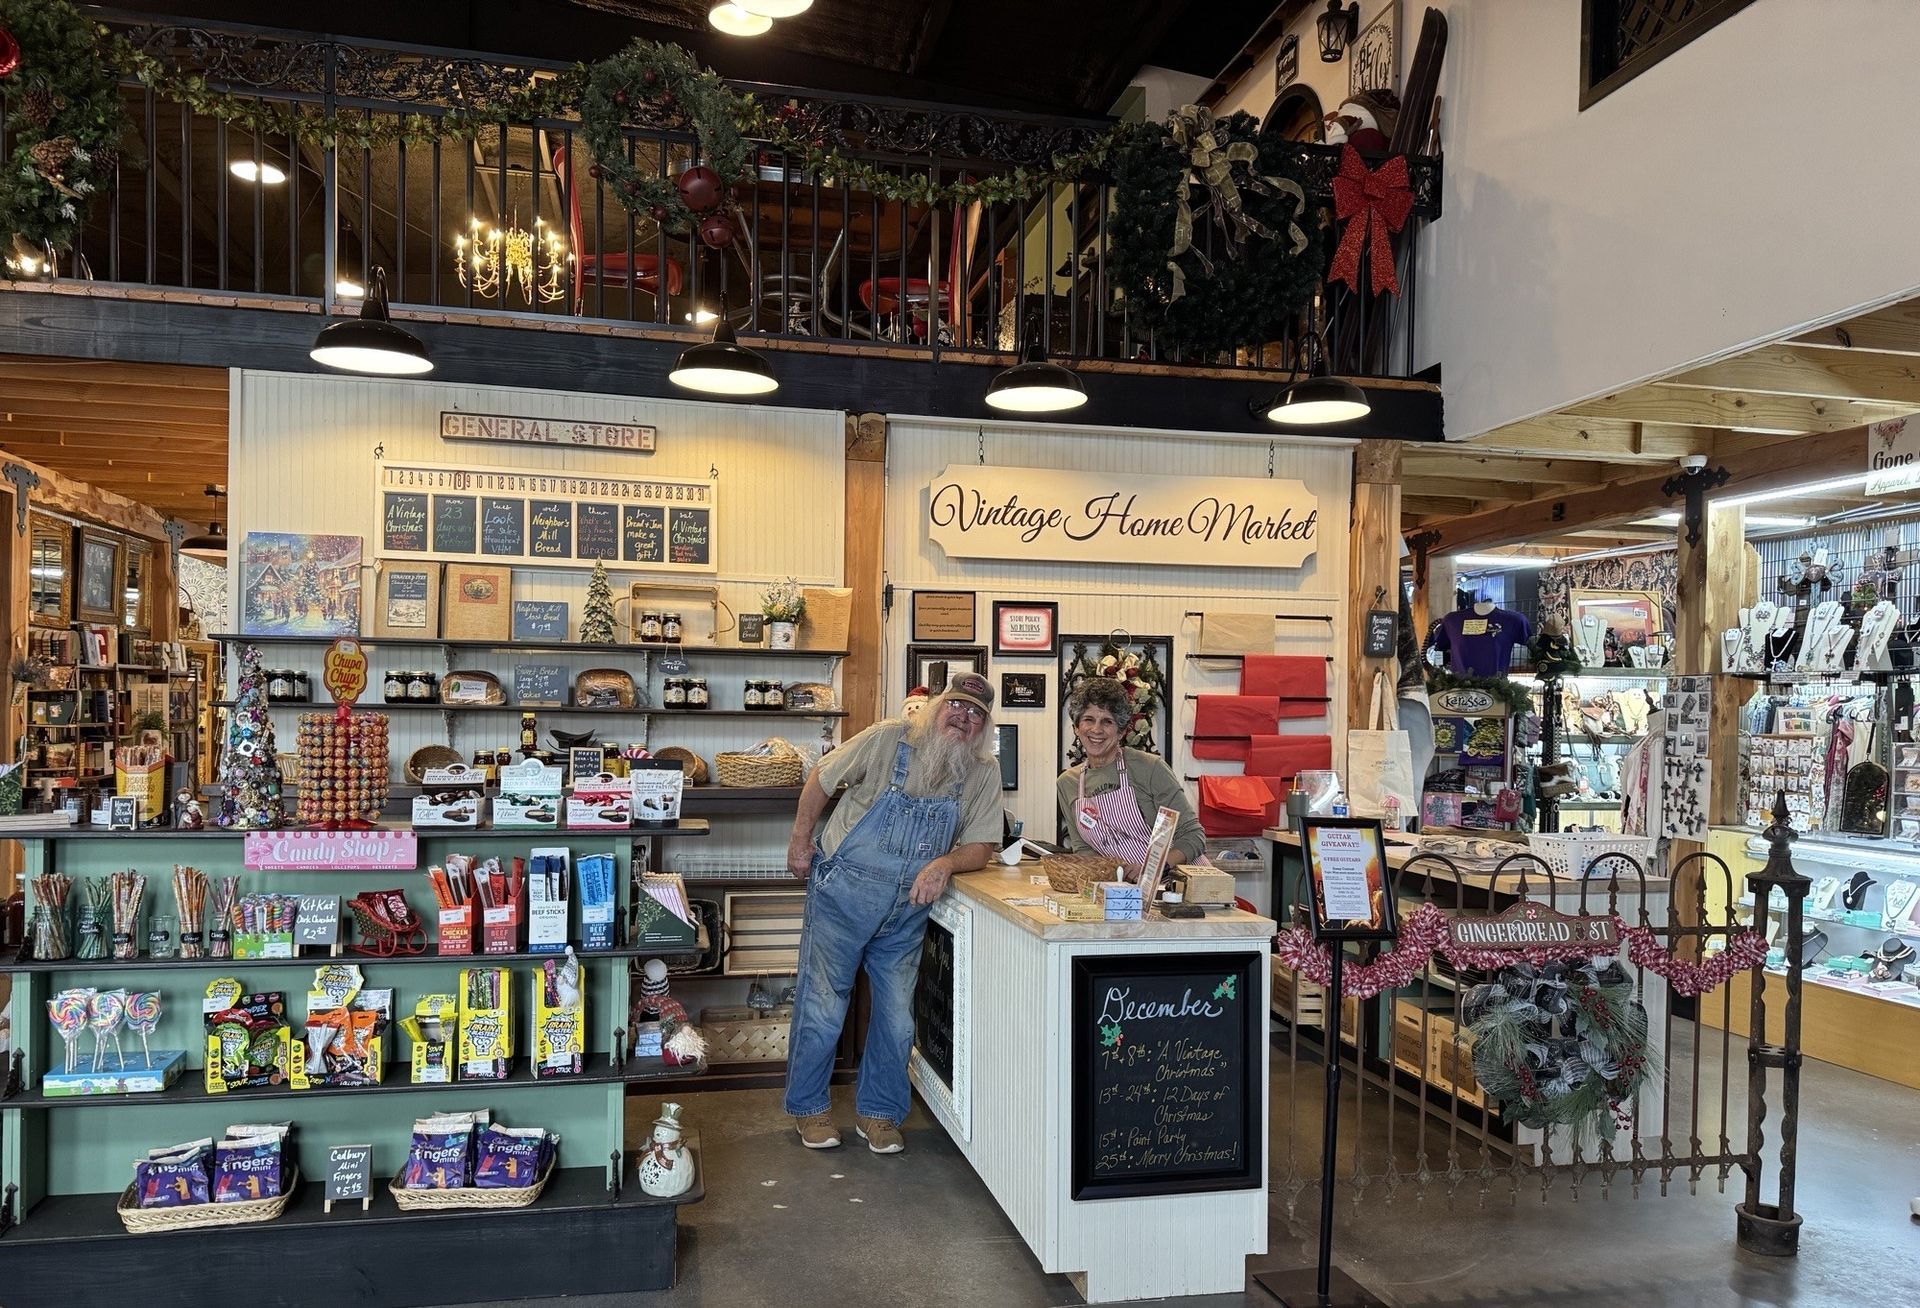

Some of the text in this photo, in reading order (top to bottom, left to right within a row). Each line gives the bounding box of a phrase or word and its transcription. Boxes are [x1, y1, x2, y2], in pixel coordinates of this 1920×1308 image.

[444, 415, 651, 449] GENERAL STORE
[1873, 451, 1913, 471] Gone
[390, 471, 394, 484] 1
[399, 471, 404, 484] 2
[409, 471, 414, 485] 3
[418, 472, 423, 486] 4
[428, 473, 433, 486] 5
[439, 473, 444, 486] 6
[457, 474, 462, 487] 8
[466, 474, 471, 488] 9
[476, 475, 483, 488] 10
[488, 475, 493, 489] 11
[497, 476, 504, 490] 12
[508, 477, 515, 490] 13
[519, 478, 526, 491] 14
[530, 479, 537, 492] 15
[540, 479, 547, 492] 16
[550, 480, 557, 493] 17
[560, 480, 567, 494] 18
[570, 480, 577, 494] 19
[579, 481, 587, 495] 20
[591, 482, 598, 495] 21
[601, 482, 608, 496] 22
[611, 483, 619, 497] 23
[622, 484, 630, 497] 24
[633, 484, 641, 498] 25
[644, 485, 652, 498] 26
[655, 486, 663, 499] 27
[666, 486, 673, 500] 28
[676, 487, 683, 500] 29
[686, 487, 694, 501] 30
[698, 488, 705, 501] 31
[388, 504, 425, 524] A Vintage
[440, 506, 463, 519] 23
[485, 509, 515, 524] Look
[930, 483, 1318, 546] Vintage Home Market
[386, 520, 424, 533] Christmas
[532, 512, 570, 530] Neighbor's
[626, 516, 663, 530] Bread Jam
[484, 524, 495, 535] for
[538, 529, 558, 541] Mill
[627, 529, 648, 539] make
[671, 519, 708, 538] A Vintage
[672, 532, 706, 545] Christmas
[491, 544, 512, 553] VHM
[535, 541, 562, 554] Bread
[580, 544, 607, 557] Wrap
[634, 541, 656, 551] great
[636, 549, 659, 561] gift!
[516, 603, 545, 617] Neighbor's
[1010, 615, 1041, 623] STORE POLICY
[1010, 624, 1041, 632] NO RETURNS
[332, 654, 363, 672] Chupa
[330, 668, 361, 685] Chups
[1445, 693, 1488, 708] Kerusso
[272, 840, 335, 864] Candy
[341, 839, 390, 863] Shop
[299, 897, 337, 912] Kit Kat
[490, 929, 509, 937] BEEF
[1457, 919, 1610, 943] GINGERBREAD ST
[326, 974, 350, 983] BRAIN
[1097, 985, 1223, 1025] December
[471, 1023, 497, 1032] BRAIN
[548, 1021, 573, 1029] BRAIN
[1174, 1037, 1223, 1064] Vintage
[1162, 1087, 1179, 1103] 12
[1180, 1085, 1210, 1107] Days
[1213, 1085, 1231, 1101] of
[1153, 1105, 1214, 1126] Christmas
[1127, 1126, 1152, 1148] Paint
[1156, 1124, 1187, 1146] Party
[414, 1147, 461, 1163] fingers
[488, 1142, 534, 1154] fingers
[512, 1149, 531, 1157] mini
[1135, 1149, 1172, 1168] Merry
[1173, 1140, 1239, 1166] Christmas!
[330, 1150, 367, 1164] Cadbury
[439, 1156, 458, 1164] mini
[221, 1156, 274, 1173] fingers
[250, 1163, 272, 1173] mini
[338, 1162, 359, 1172] Mini
[333, 1172, 363, 1183] Fingers
